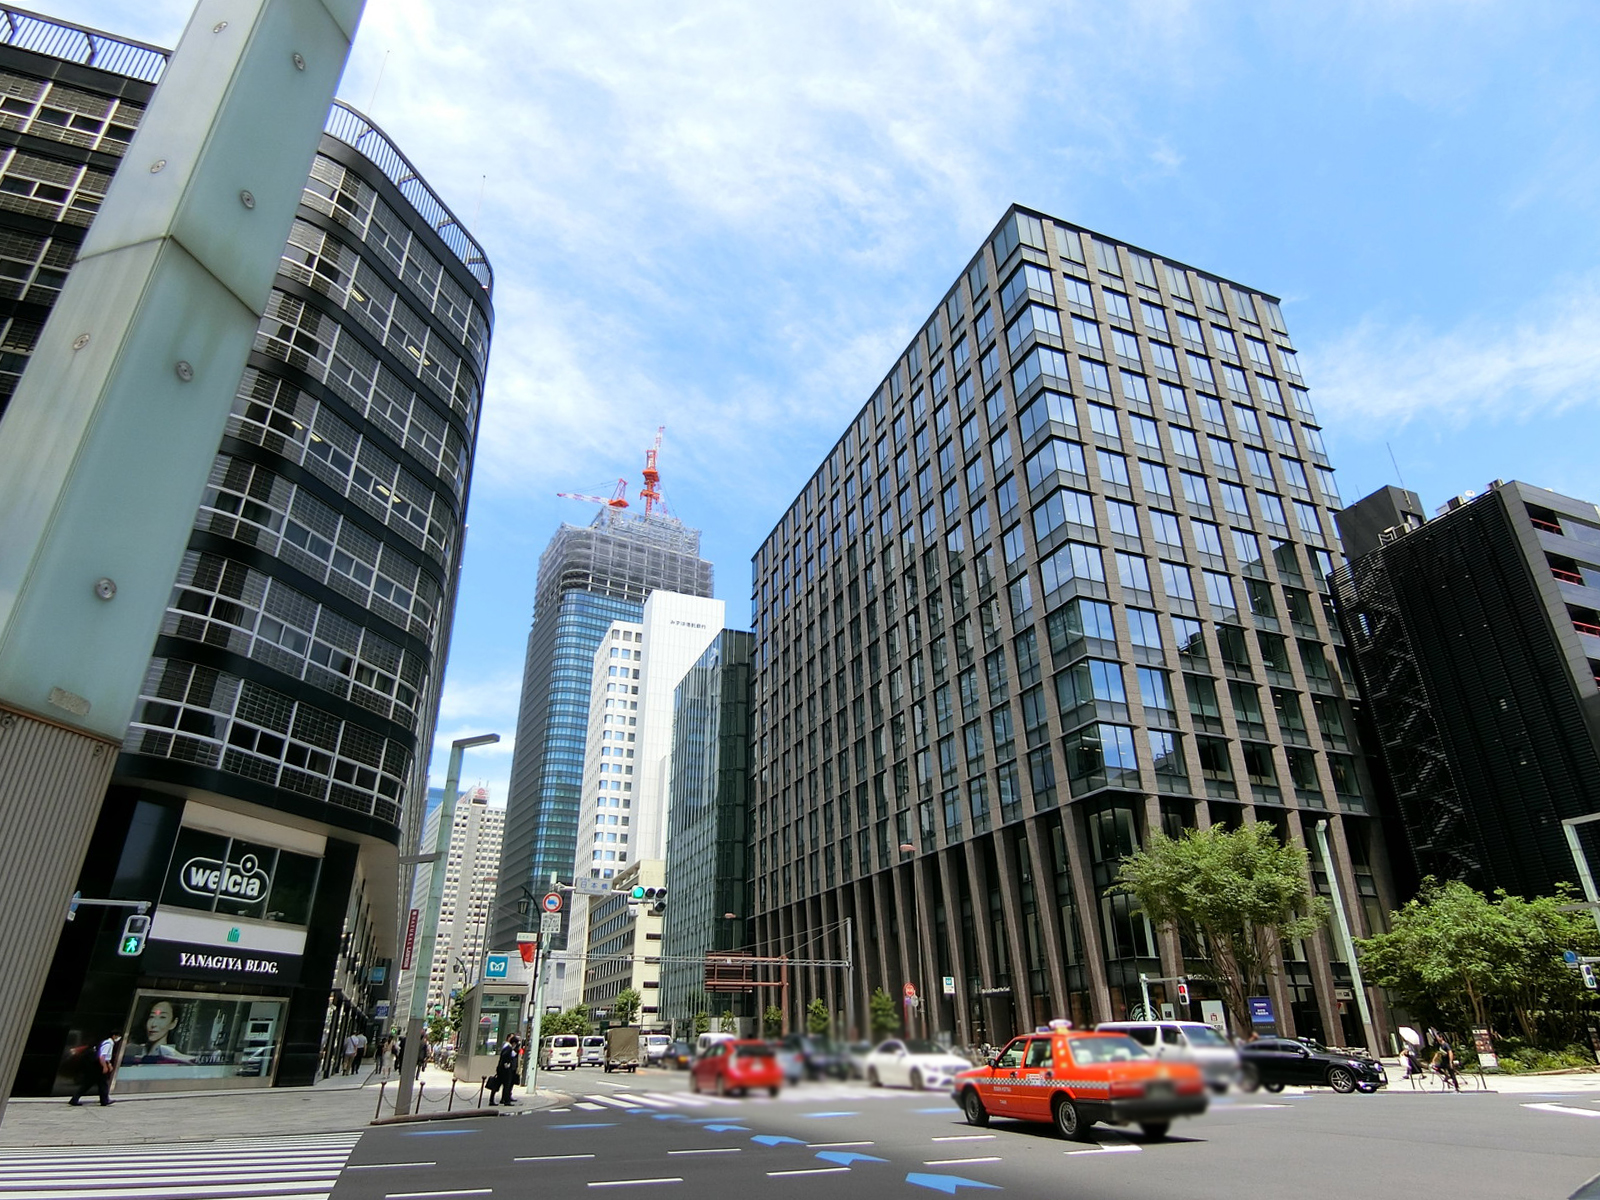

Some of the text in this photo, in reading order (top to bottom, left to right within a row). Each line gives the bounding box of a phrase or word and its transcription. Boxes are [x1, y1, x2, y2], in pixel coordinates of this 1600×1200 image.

[190, 855, 261, 896] welcia
[180, 952, 279, 974] YANAGIYA BLDG.
